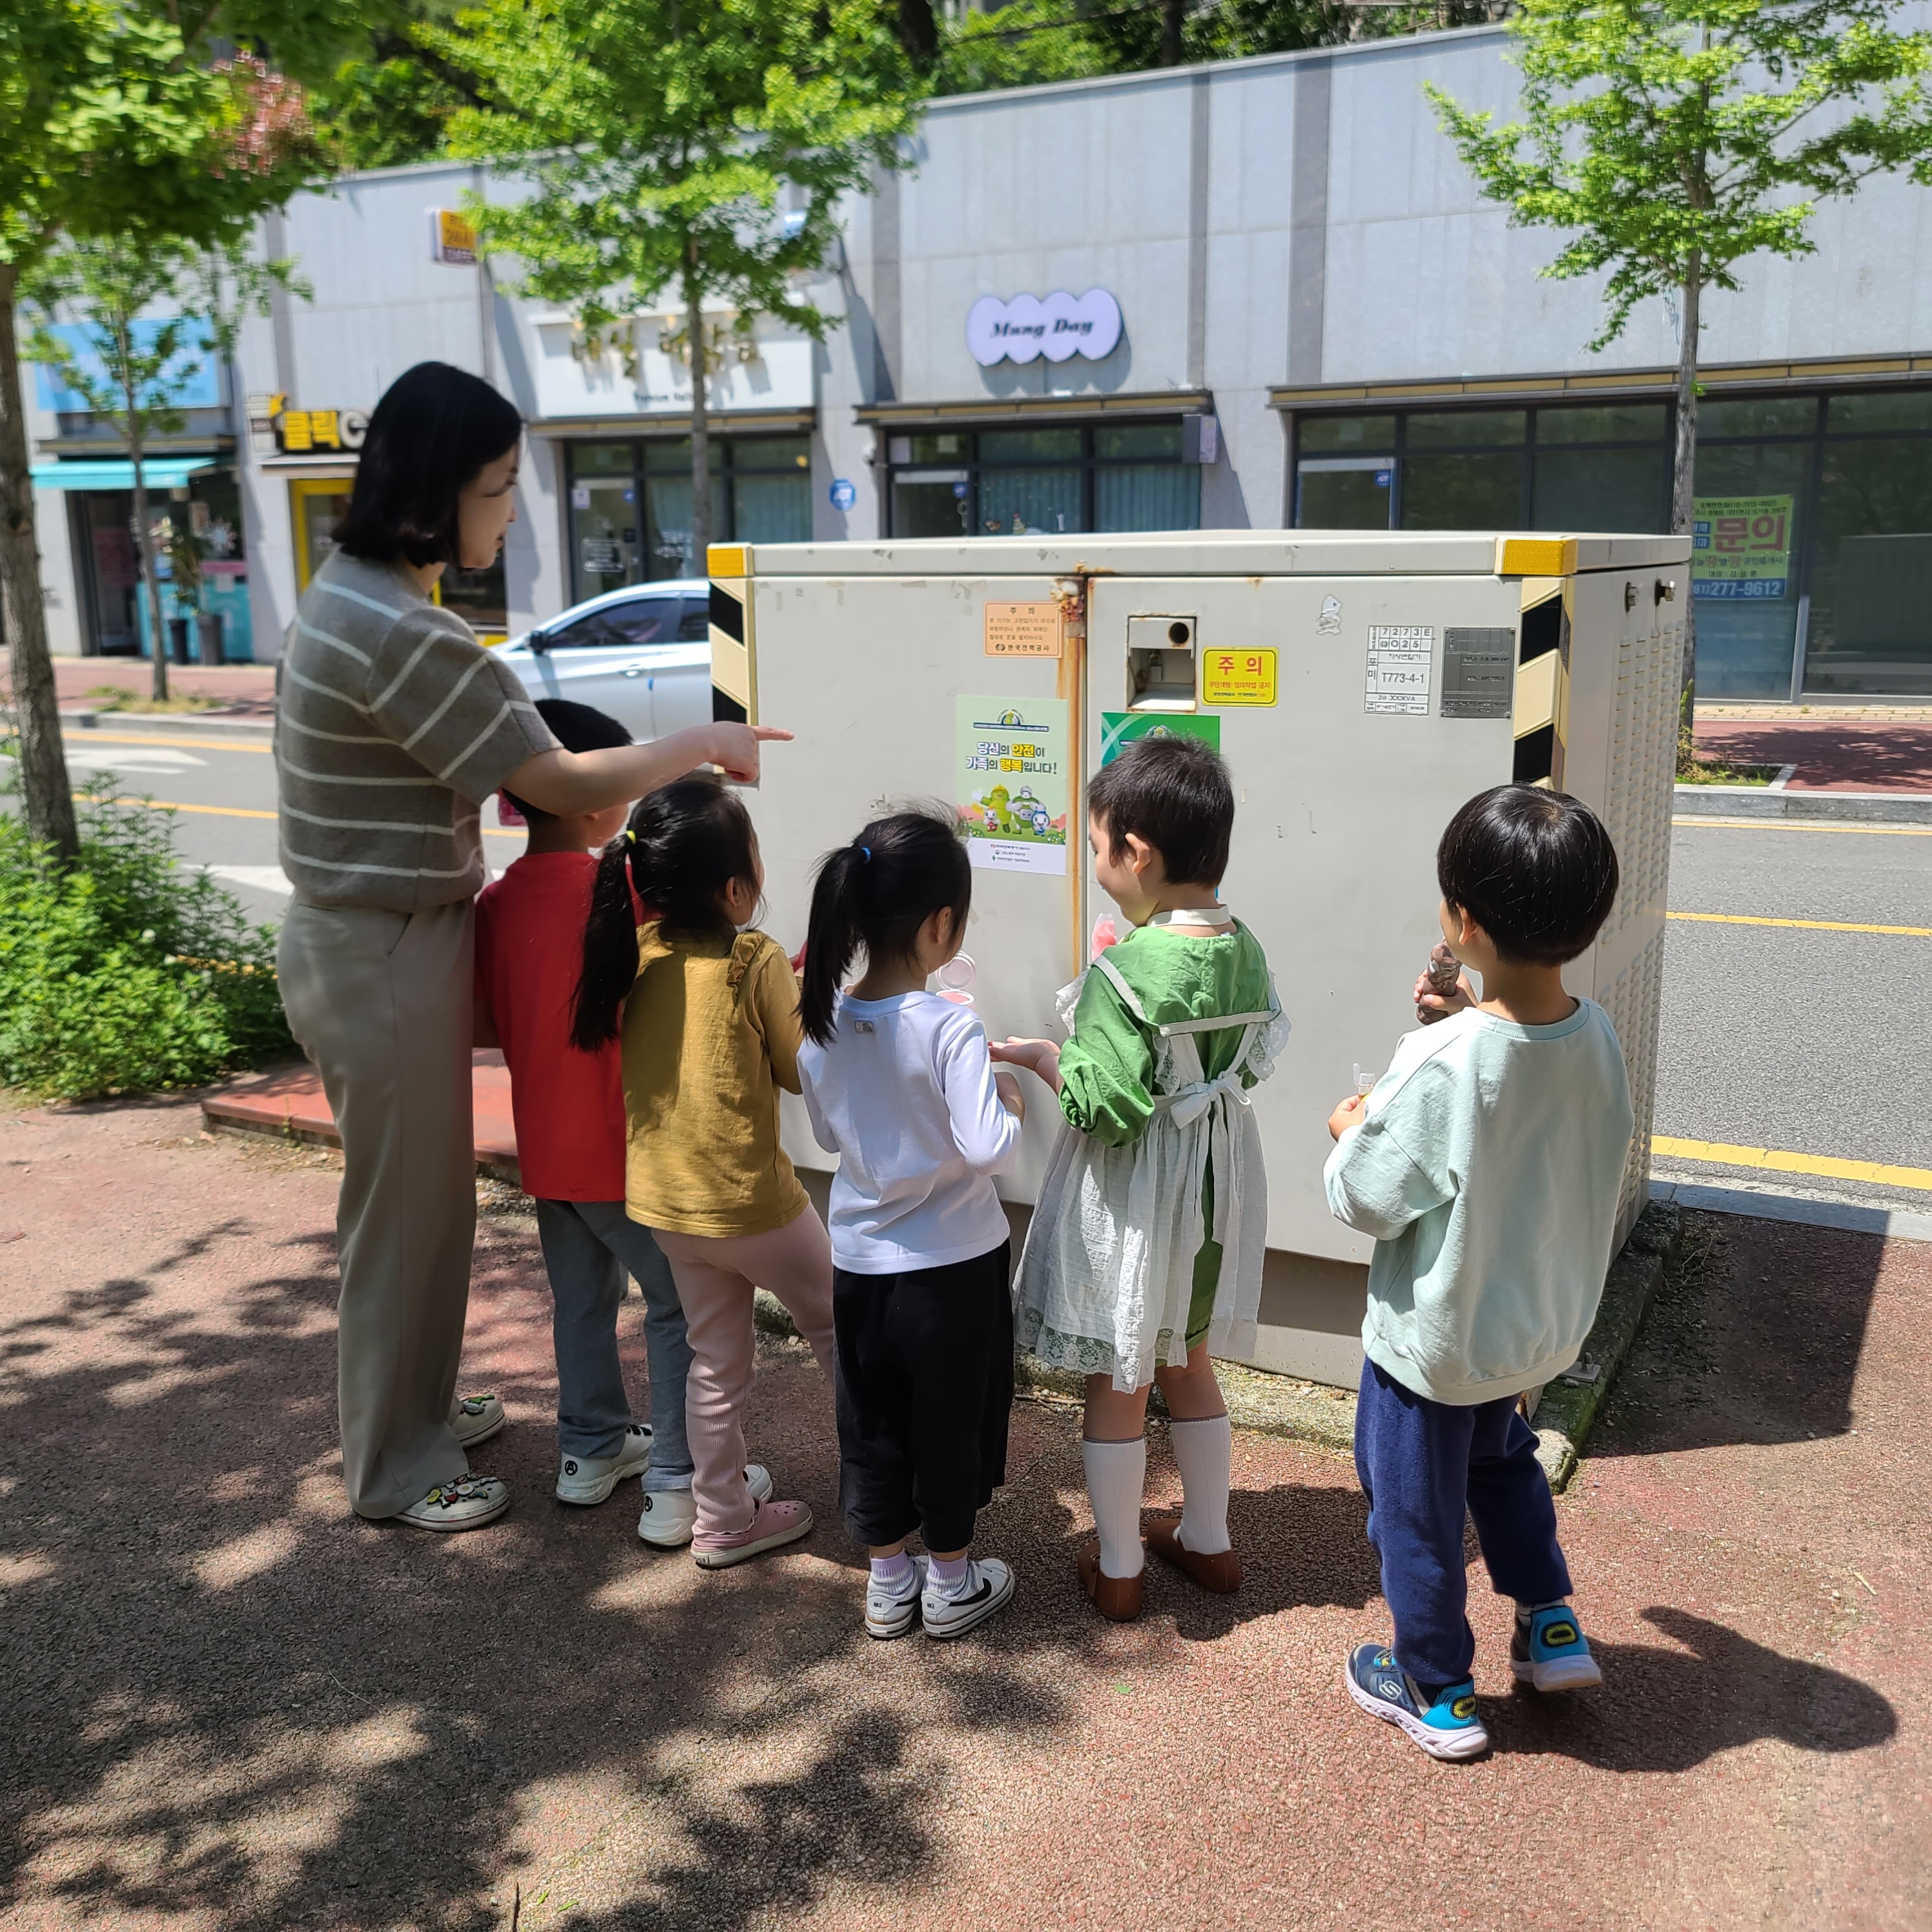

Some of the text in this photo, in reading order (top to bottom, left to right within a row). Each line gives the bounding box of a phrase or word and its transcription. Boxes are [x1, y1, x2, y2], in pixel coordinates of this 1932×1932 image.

[991, 319, 1093, 338] Mung Day
[1714, 514, 1785, 553] 문의
[1694, 582, 1780, 596] 61)277-9612
[1381, 672, 1424, 684] T773-4-1
[977, 741, 1045, 758] 당신의 안전이
[965, 756, 1057, 775] 가족의 행복입니다!
